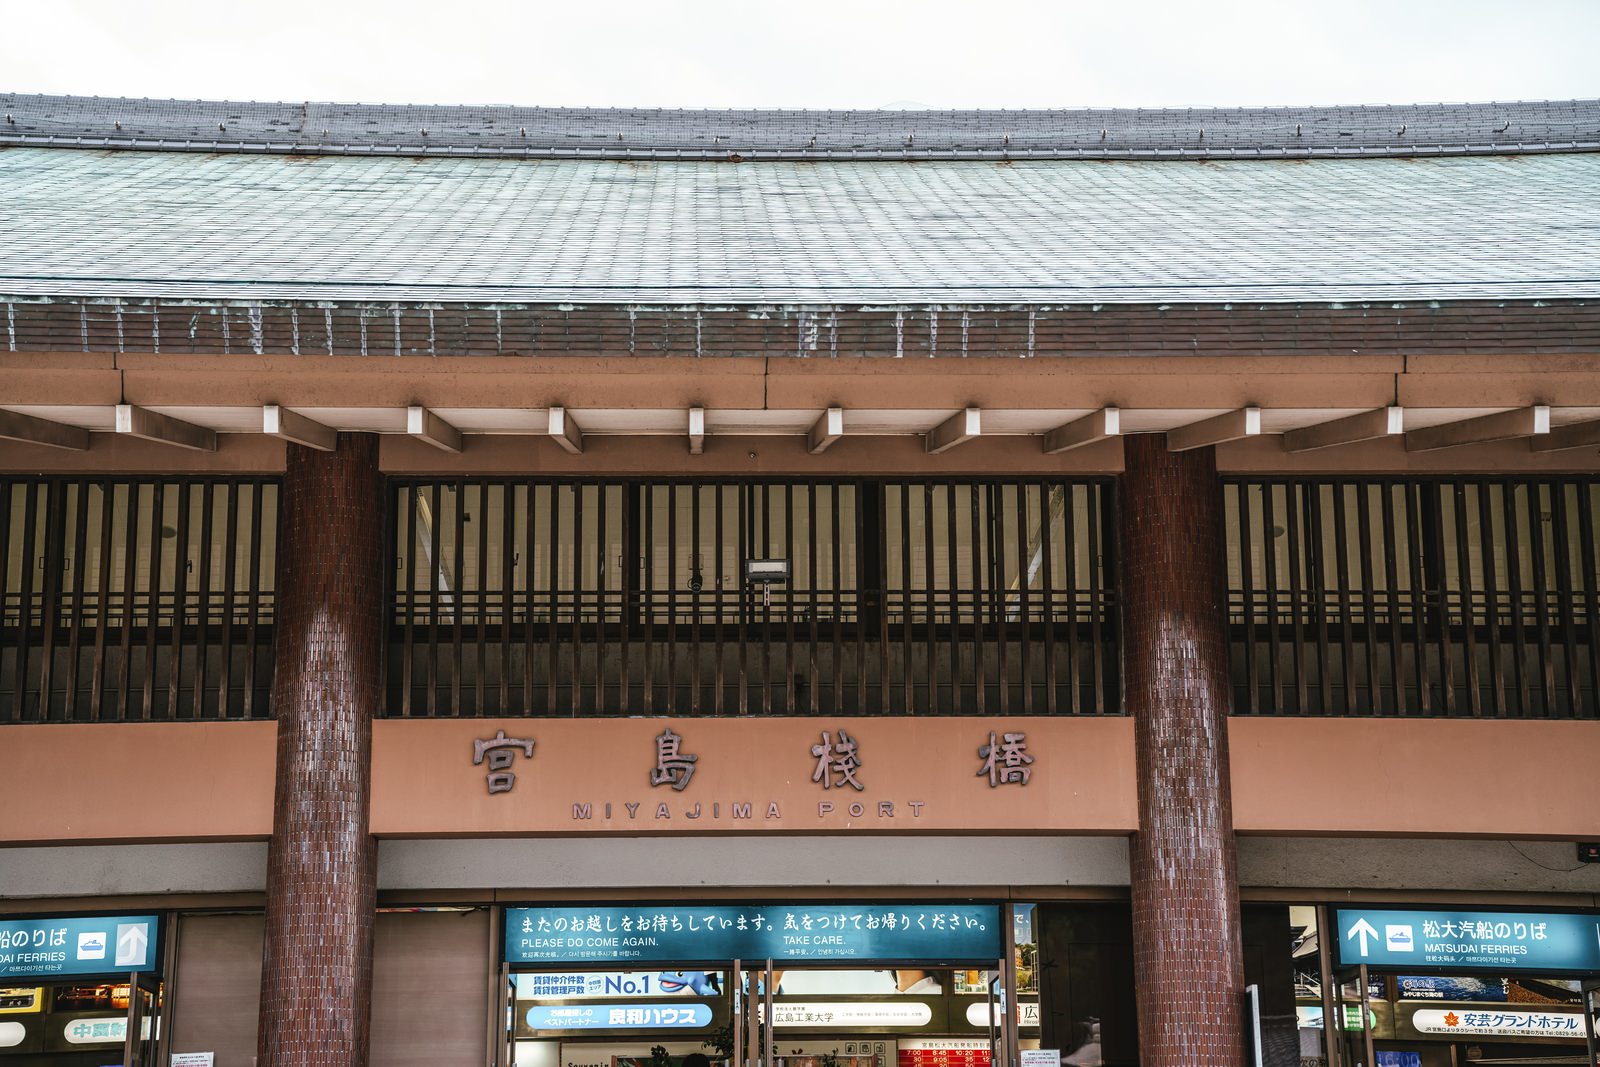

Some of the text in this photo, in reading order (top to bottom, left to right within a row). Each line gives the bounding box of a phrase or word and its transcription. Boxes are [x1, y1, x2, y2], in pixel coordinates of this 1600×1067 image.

[572, 801, 926, 820] MIYAJIMA PORT
[521, 912, 987, 933] またのお越しをお待ちしています。 気をつけてお帰りください。
[1422, 919, 1548, 941] 松大汽船のりば
[521, 936, 659, 948] PLEASE DO COME AGAIN.
[783, 935, 846, 945] TAKE CARE.
[17, 951, 66, 962] FERRIES
[1424, 943, 1528, 955] MATSUDAI FERRIES
[605, 975, 649, 994] No.1
[608, 1008, 697, 1025] 良和ハウス
[774, 1012, 835, 1023] 広島工業大学
[1463, 1013, 1579, 1030] 安芸グランドホテル
[73, 1022, 127, 1038] 中國新
